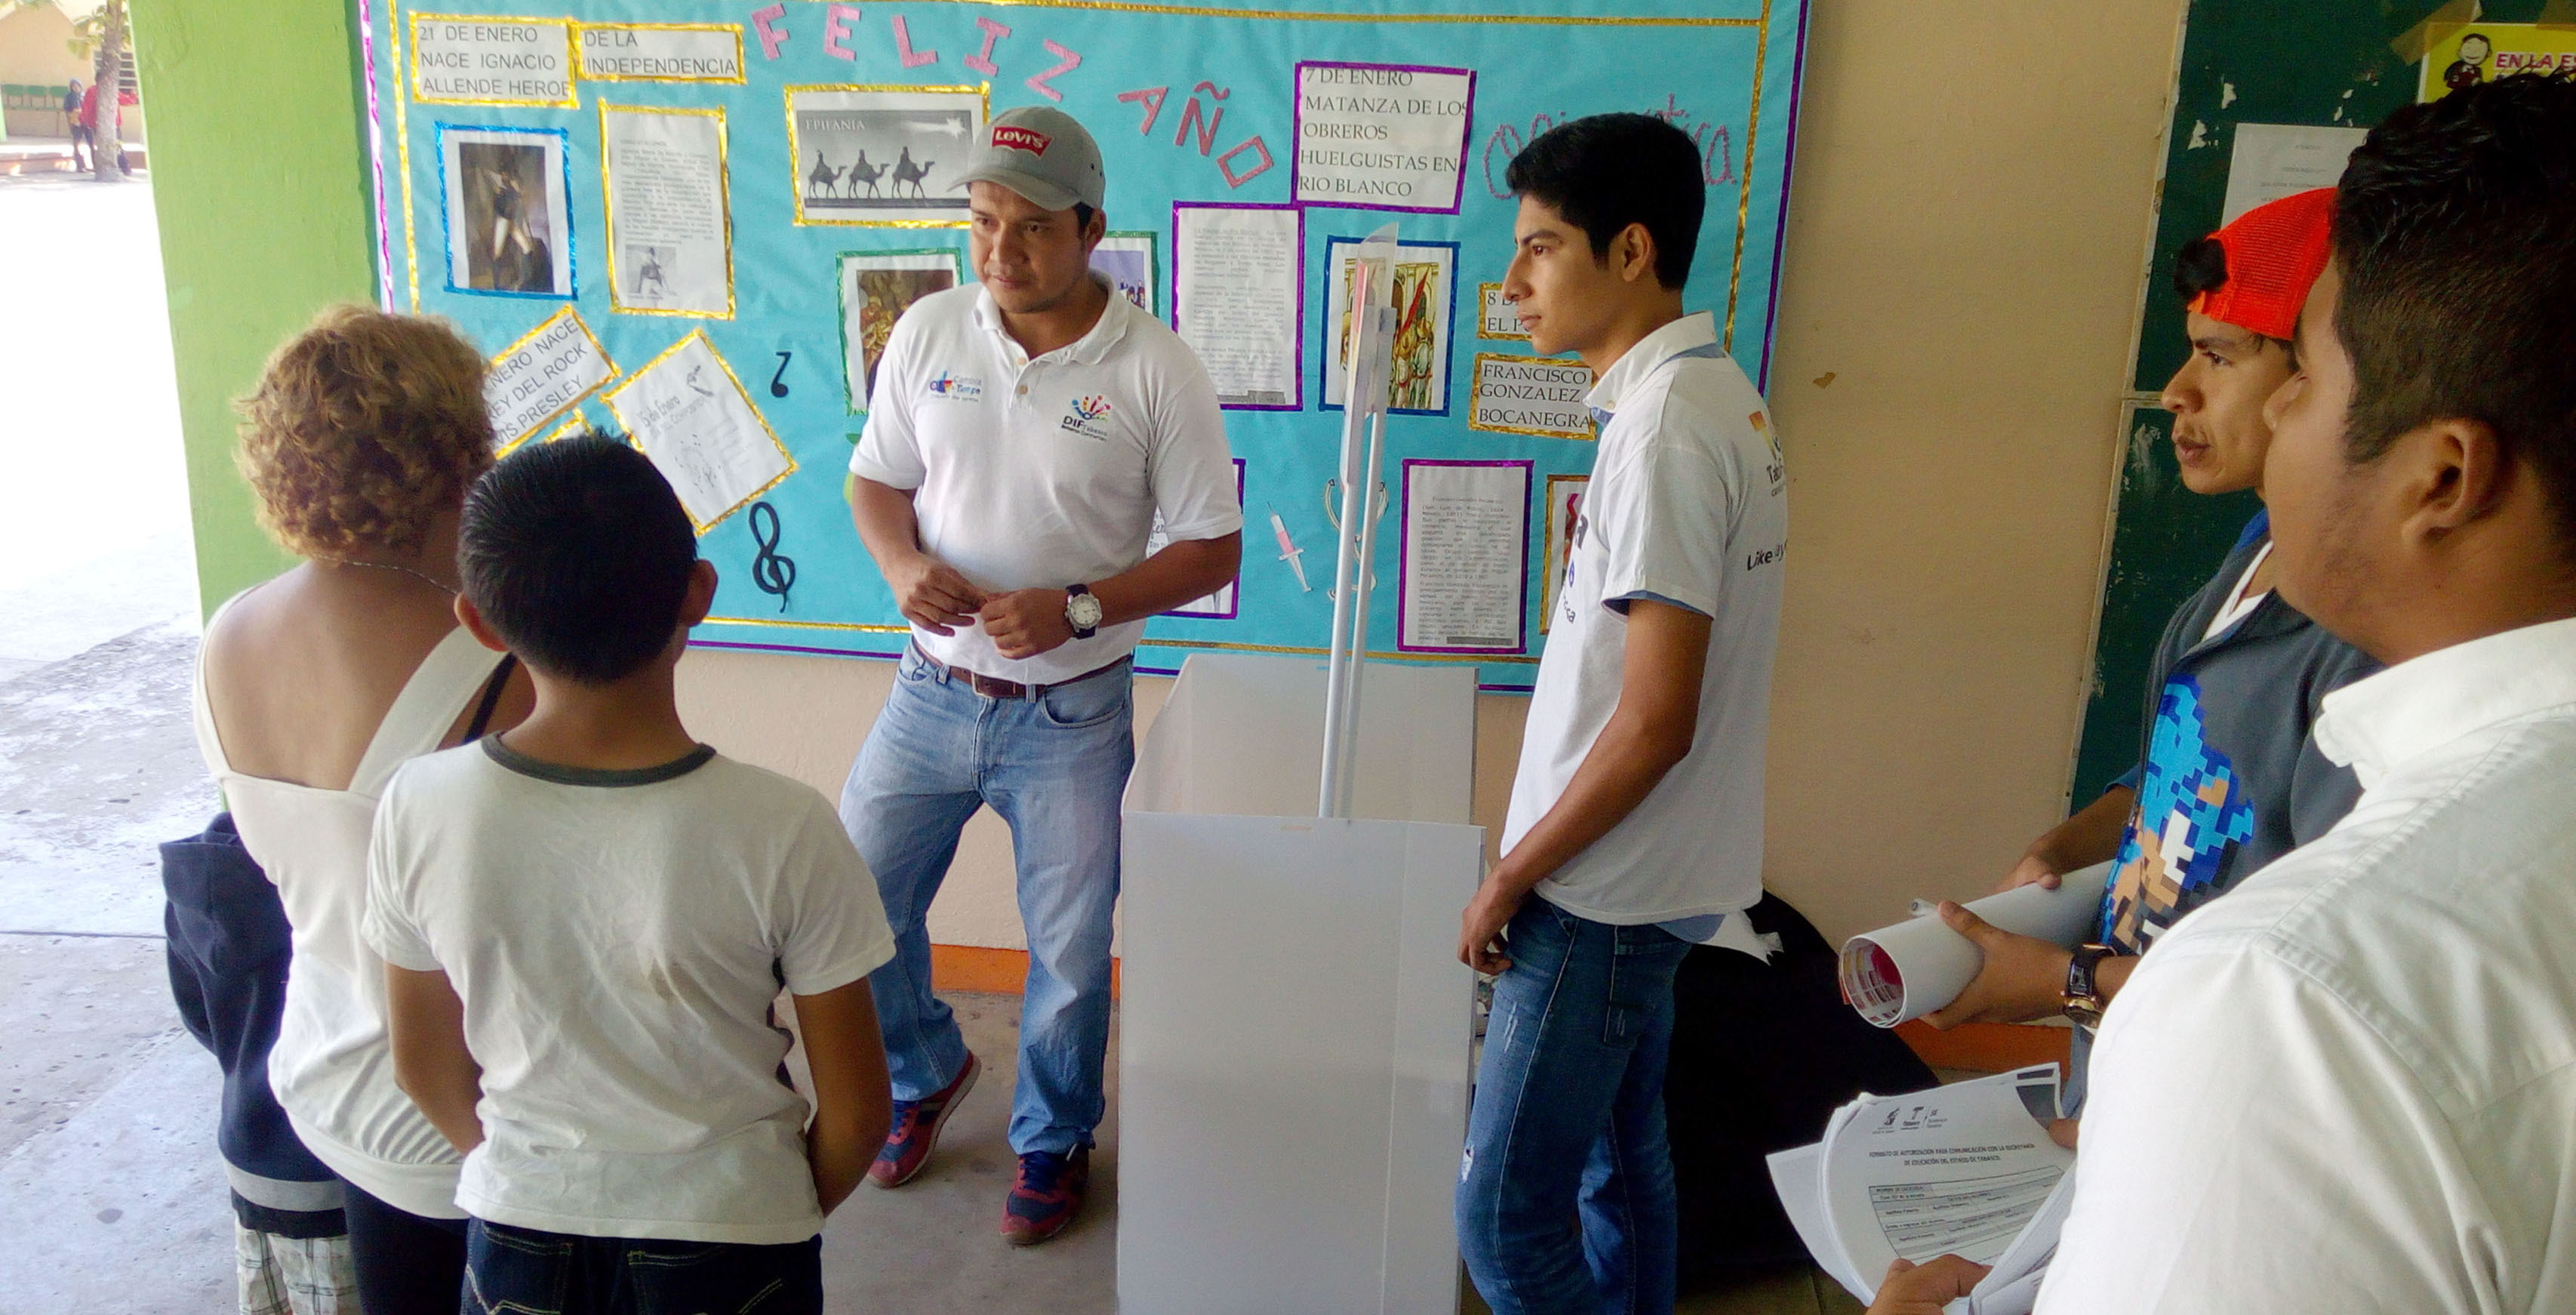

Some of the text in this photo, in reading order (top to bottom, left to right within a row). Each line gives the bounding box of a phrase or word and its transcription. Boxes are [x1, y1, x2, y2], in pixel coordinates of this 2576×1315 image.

[420, 26, 537, 42] 21 DE ENERO
[584, 31, 638, 47] DE LA
[421, 53, 556, 70] NACE IGNACIO
[587, 57, 737, 74] INDEPENDENCIA
[2497, 54, 2523, 68] EN
[423, 78, 502, 94] ALLENDE
[1306, 67, 1413, 87] 7 DE ENERO
[751, 3, 1274, 189] FELIZ AÑO
[1306, 96, 1401, 113] MATANZA
[1408, 100, 1432, 115] DE
[1303, 123, 1388, 140] OBREROS
[1300, 149, 1457, 172] HUELGUISTAS EN
[1299, 176, 1412, 196] RIO BLANCO
[1487, 291, 1496, 306] 8
[1487, 317, 1508, 331] EL
[489, 318, 579, 388] NERO NACE
[512, 377, 546, 402] DEL
[543, 342, 587, 380] ROCK
[1483, 364, 1587, 385] FRANCISCO
[517, 374, 583, 429] PRESLEY
[1480, 383, 1580, 402] GONZALEZ
[1479, 408, 1590, 428] BOCANEGRA
